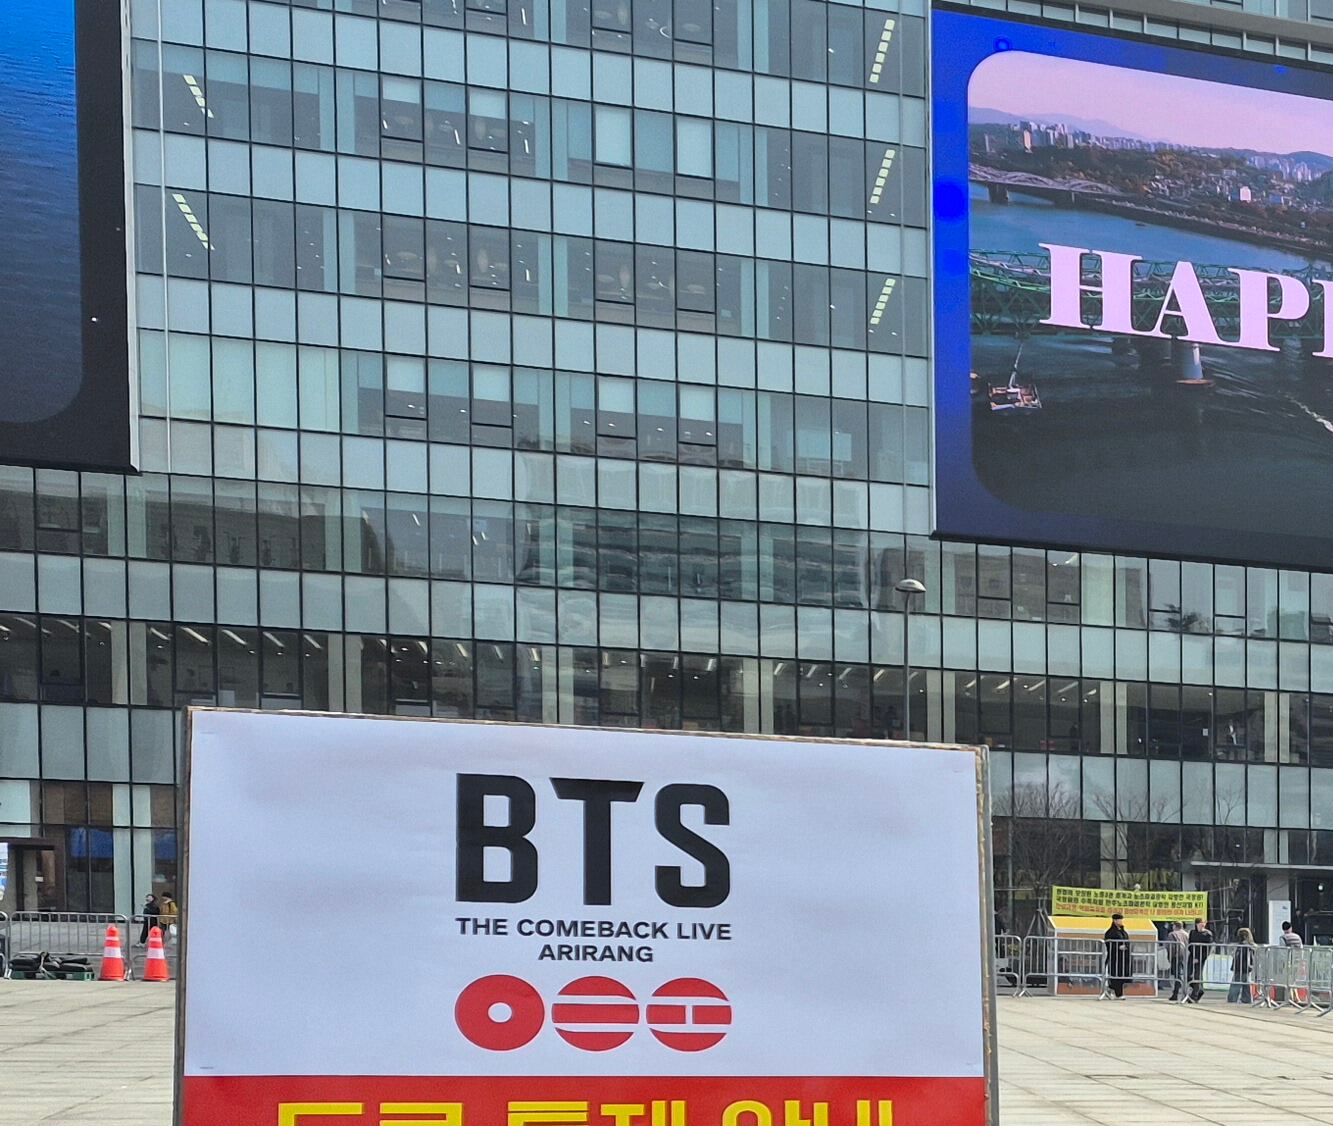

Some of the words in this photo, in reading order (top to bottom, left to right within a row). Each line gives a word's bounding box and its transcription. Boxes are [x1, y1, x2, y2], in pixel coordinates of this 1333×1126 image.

[456, 773, 730, 908] BTS
[456, 916, 508, 937] THE
[517, 918, 670, 941] COMEBACK
[677, 920, 732, 941] LIVE
[538, 944, 654, 963] ARIRANG
